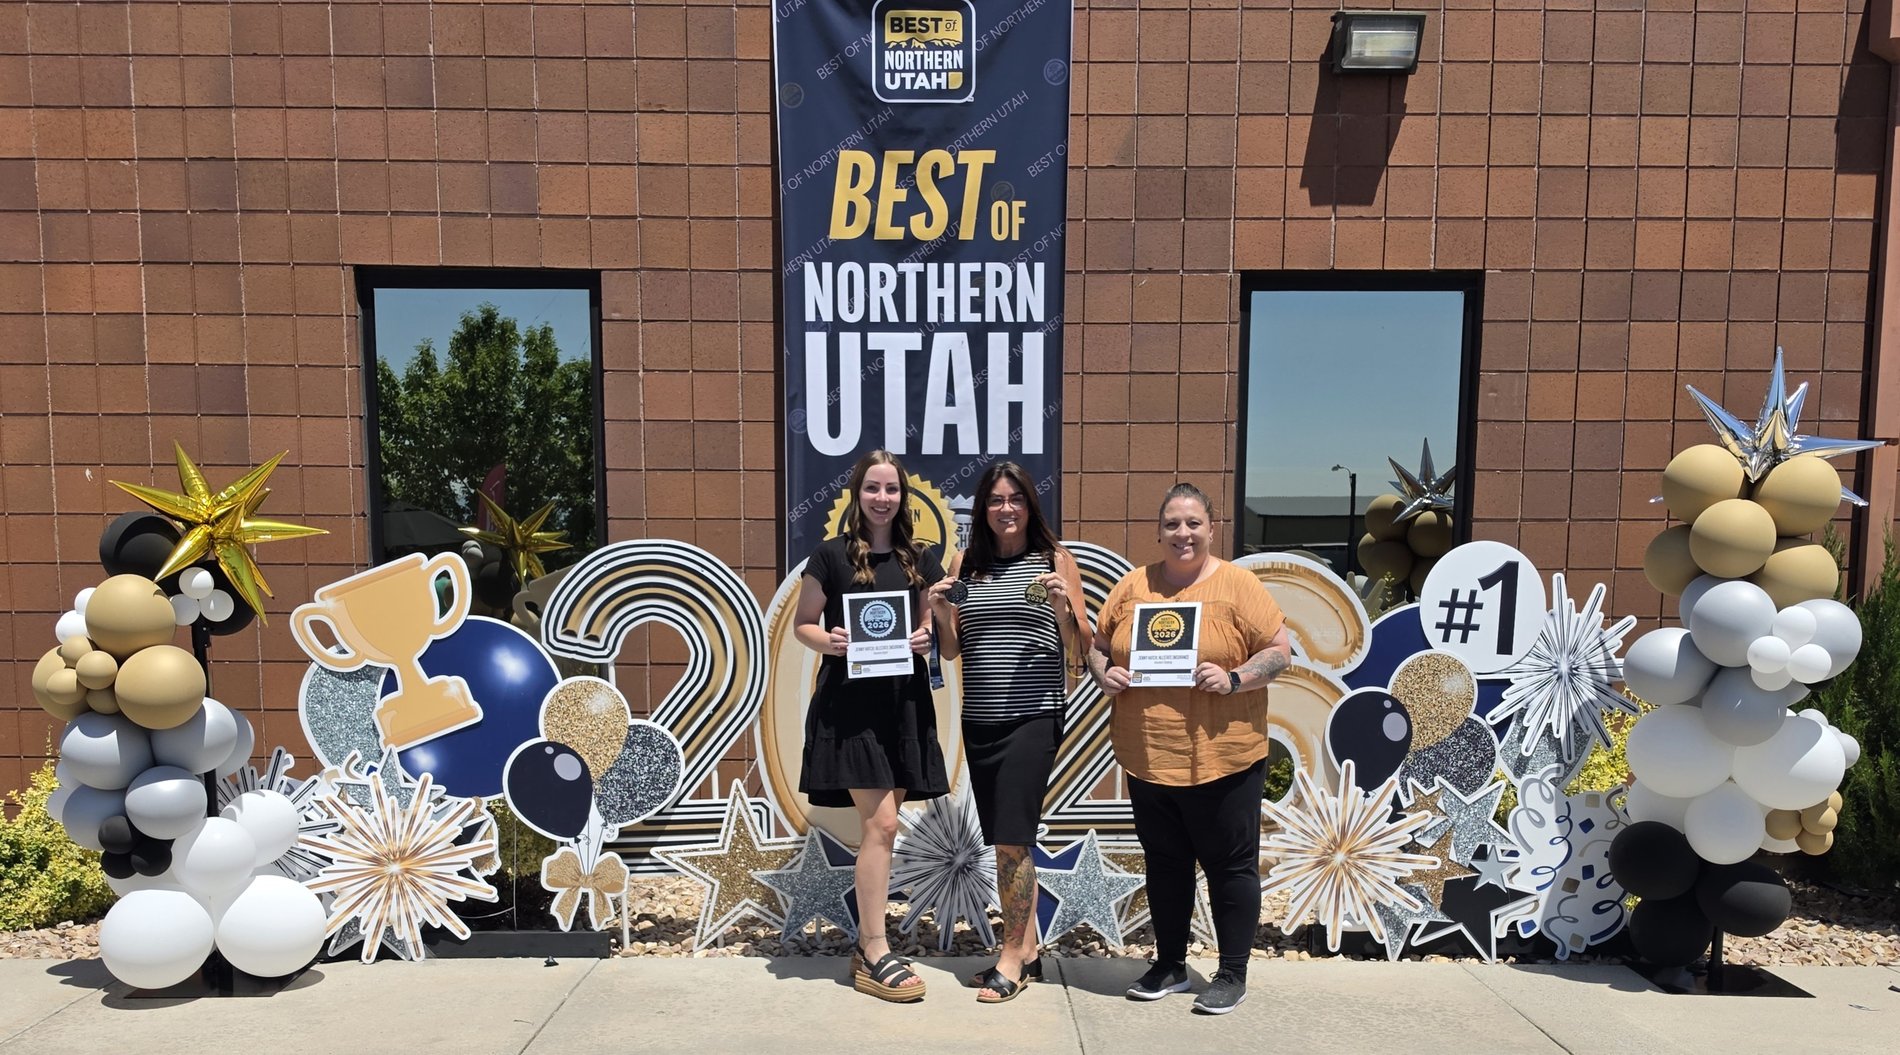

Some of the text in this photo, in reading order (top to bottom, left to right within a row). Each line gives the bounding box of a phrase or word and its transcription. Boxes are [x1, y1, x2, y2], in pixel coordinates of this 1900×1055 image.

[779, 0, 806, 18] UTA
[889, 17, 943, 34] BEST
[816, 53, 844, 80] BEST
[844, 39, 862, 58] OF
[884, 50, 963, 70] NORTHERN
[975, 34, 990, 52] OF
[884, 72, 947, 90] UTAH
[946, 91, 1030, 156] ORTHERN UTAH
[787, 172, 803, 190] OF
[803, 130, 863, 178] NORTHERN
[861, 106, 895, 135] UTAH
[1026, 140, 1067, 178] BEST O
[829, 148, 1027, 241] BEST OF
[811, 235, 840, 255] UTA
[1006, 235, 1051, 273] BEST OF
[803, 261, 1045, 323] NORTHERN
[804, 331, 1044, 456] UTAH
[940, 461, 979, 493] EST OF
[1034, 475, 1055, 496] EST
[788, 498, 813, 522] BEST
[813, 486, 830, 503] OF
[867, 621, 889, 629] 2026
[1435, 560, 1519, 655] #1
